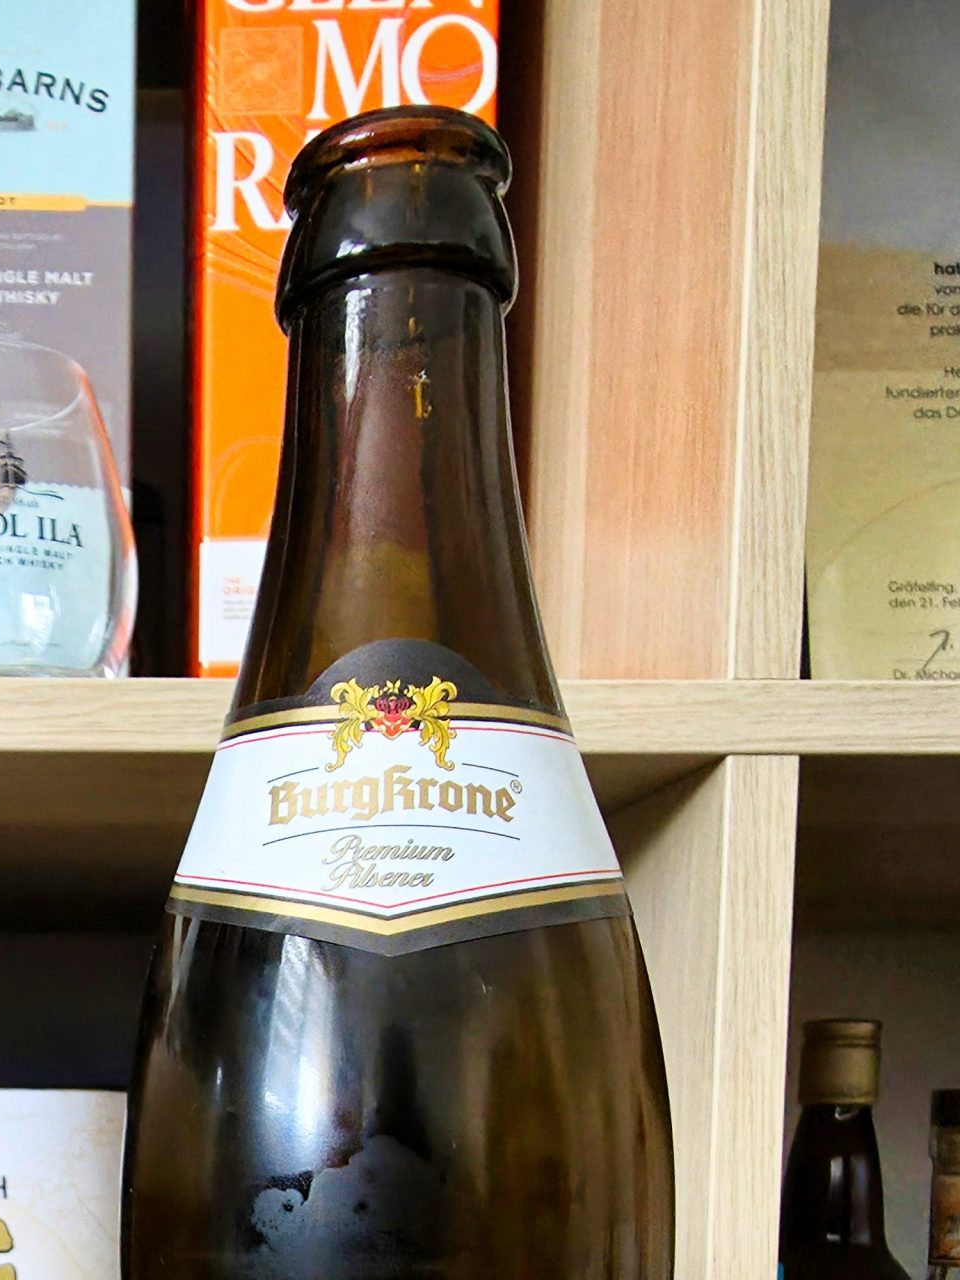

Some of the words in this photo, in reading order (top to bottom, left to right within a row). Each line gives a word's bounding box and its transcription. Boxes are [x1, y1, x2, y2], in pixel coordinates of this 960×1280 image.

[44, 271, 93, 286] MALT
[37, 516, 83, 547] ILA
[325, 834, 455, 865] Premium
[321, 861, 434, 891] Pilsener
